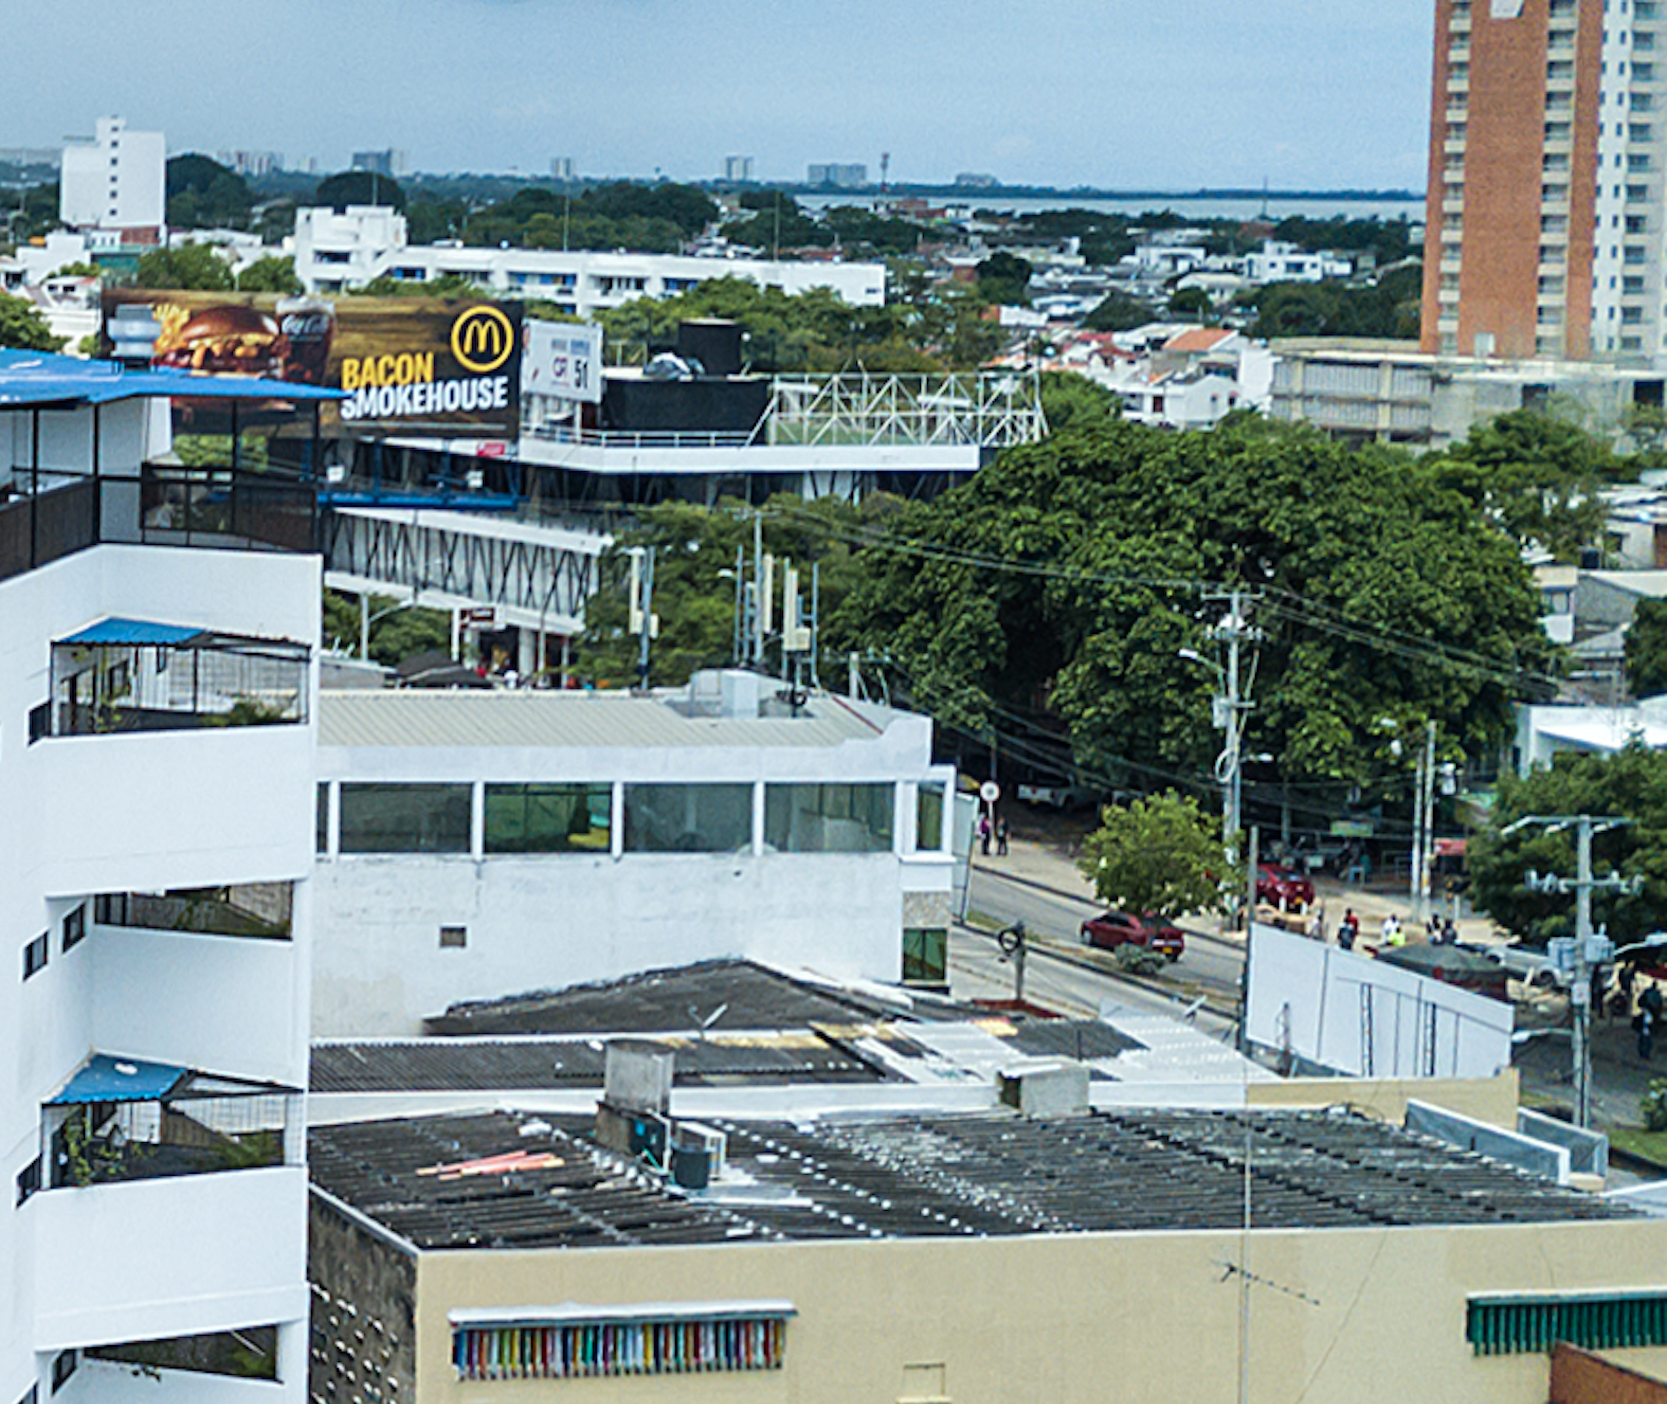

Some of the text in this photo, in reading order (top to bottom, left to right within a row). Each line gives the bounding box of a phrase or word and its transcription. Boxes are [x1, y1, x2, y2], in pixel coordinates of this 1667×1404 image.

[341, 351, 435, 390] BACON
[574, 359, 589, 389] 51
[340, 375, 509, 420] SMOKEHOUSE
